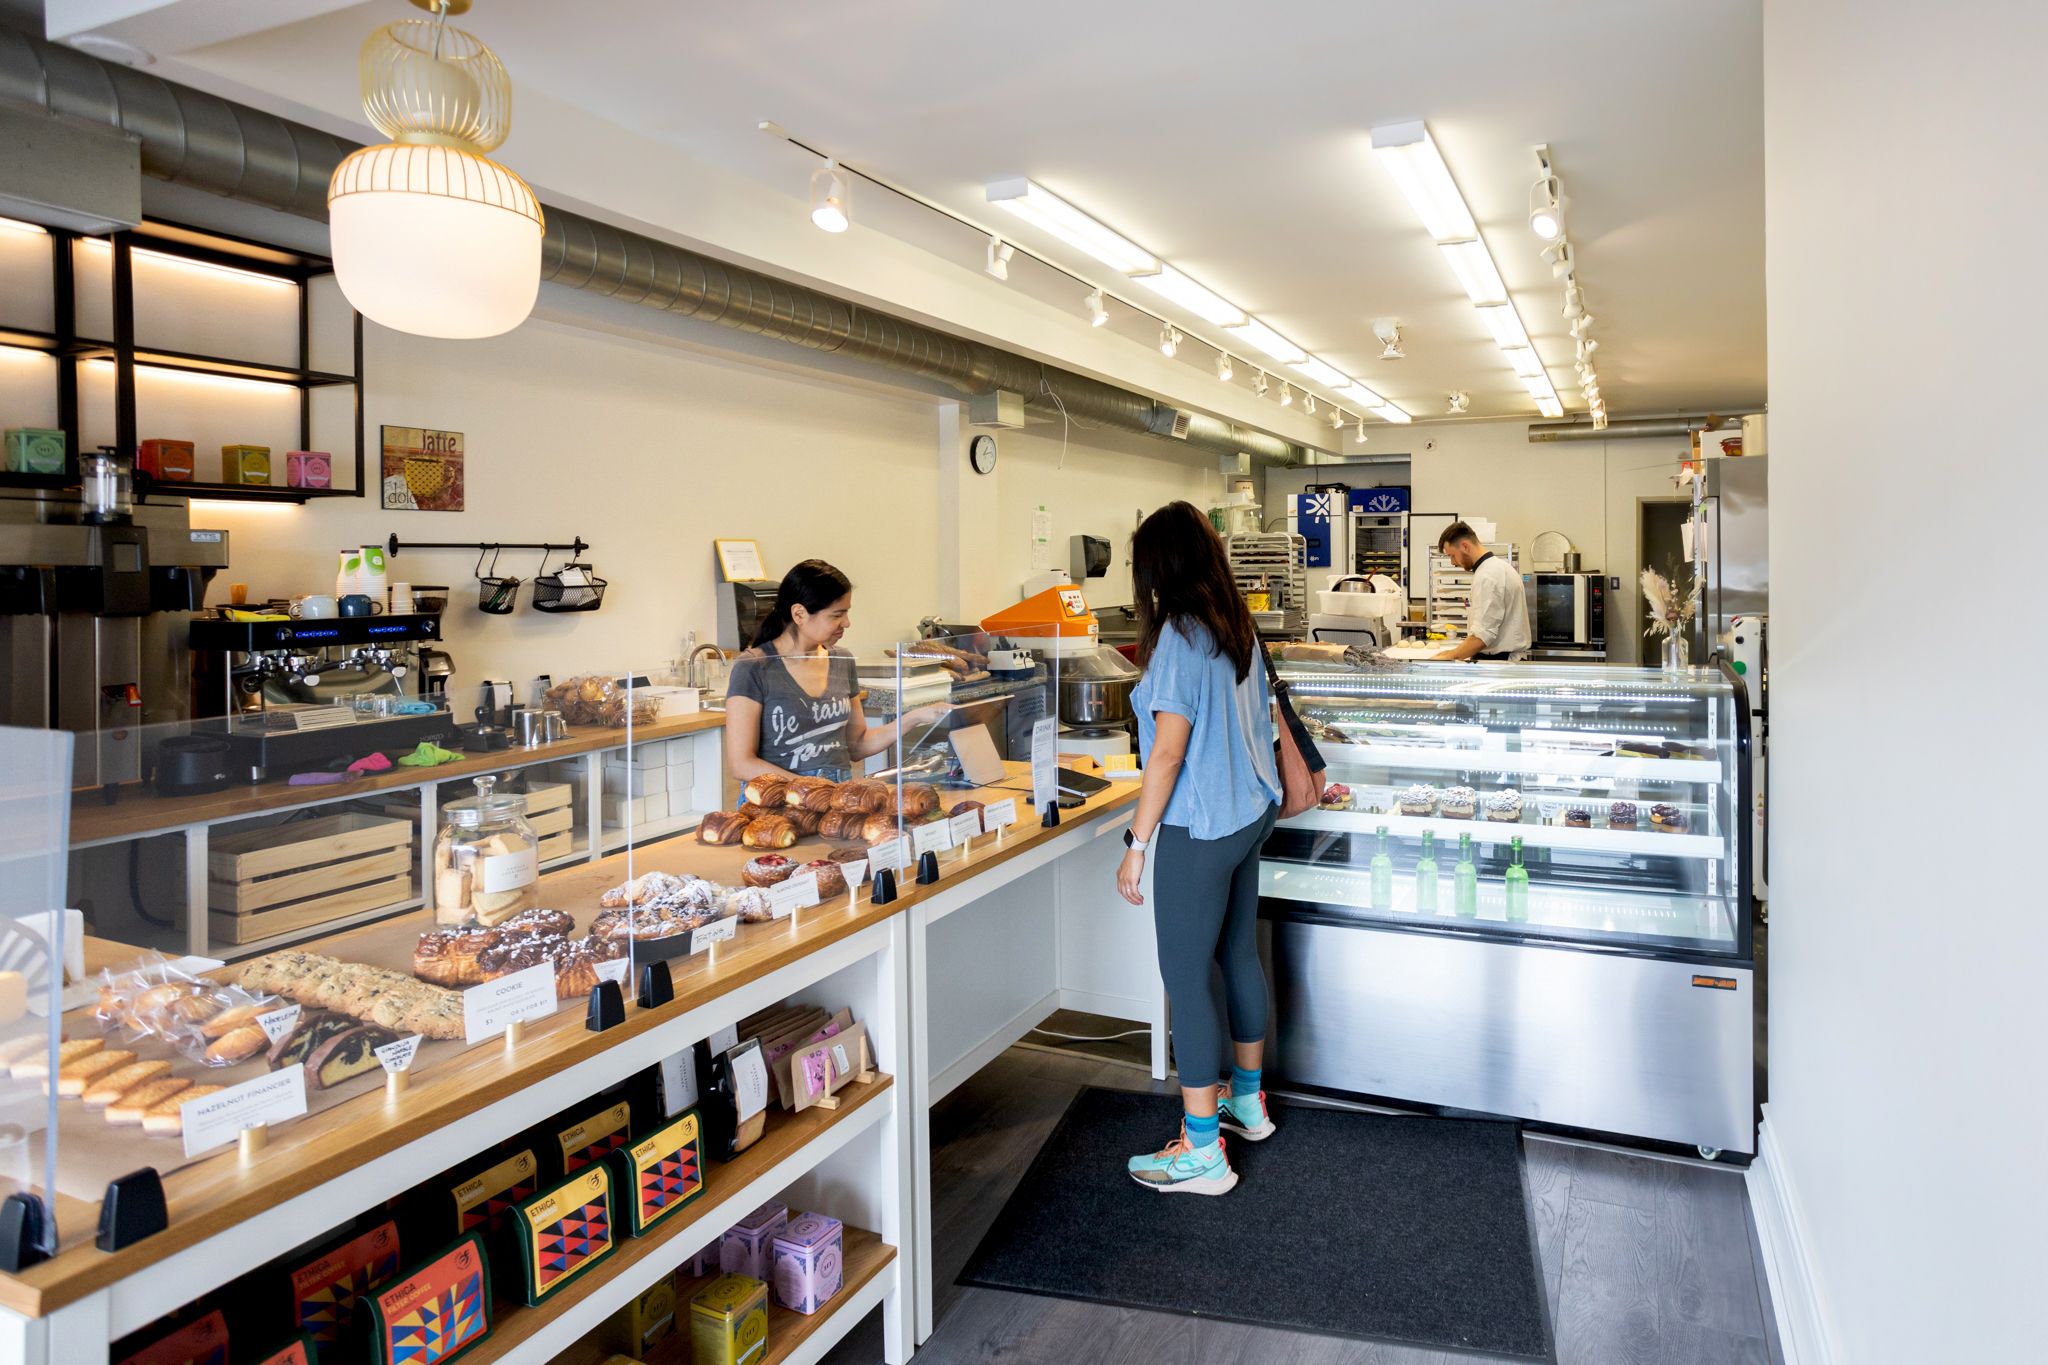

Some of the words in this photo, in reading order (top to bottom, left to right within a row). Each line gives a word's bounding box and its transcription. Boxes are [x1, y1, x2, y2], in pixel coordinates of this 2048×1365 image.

[495, 981, 523, 996] COOKIE
[246, 1077, 292, 1098] FINANCIER
[563, 1126, 585, 1143] ETHICA
[635, 1141, 656, 1158] ETHICA
[457, 1179, 484, 1198] ETHICA
[530, 1198, 557, 1218] ETHICA
[383, 1282, 417, 1307] ETHICA
[409, 1282, 433, 1302] COFFEE
